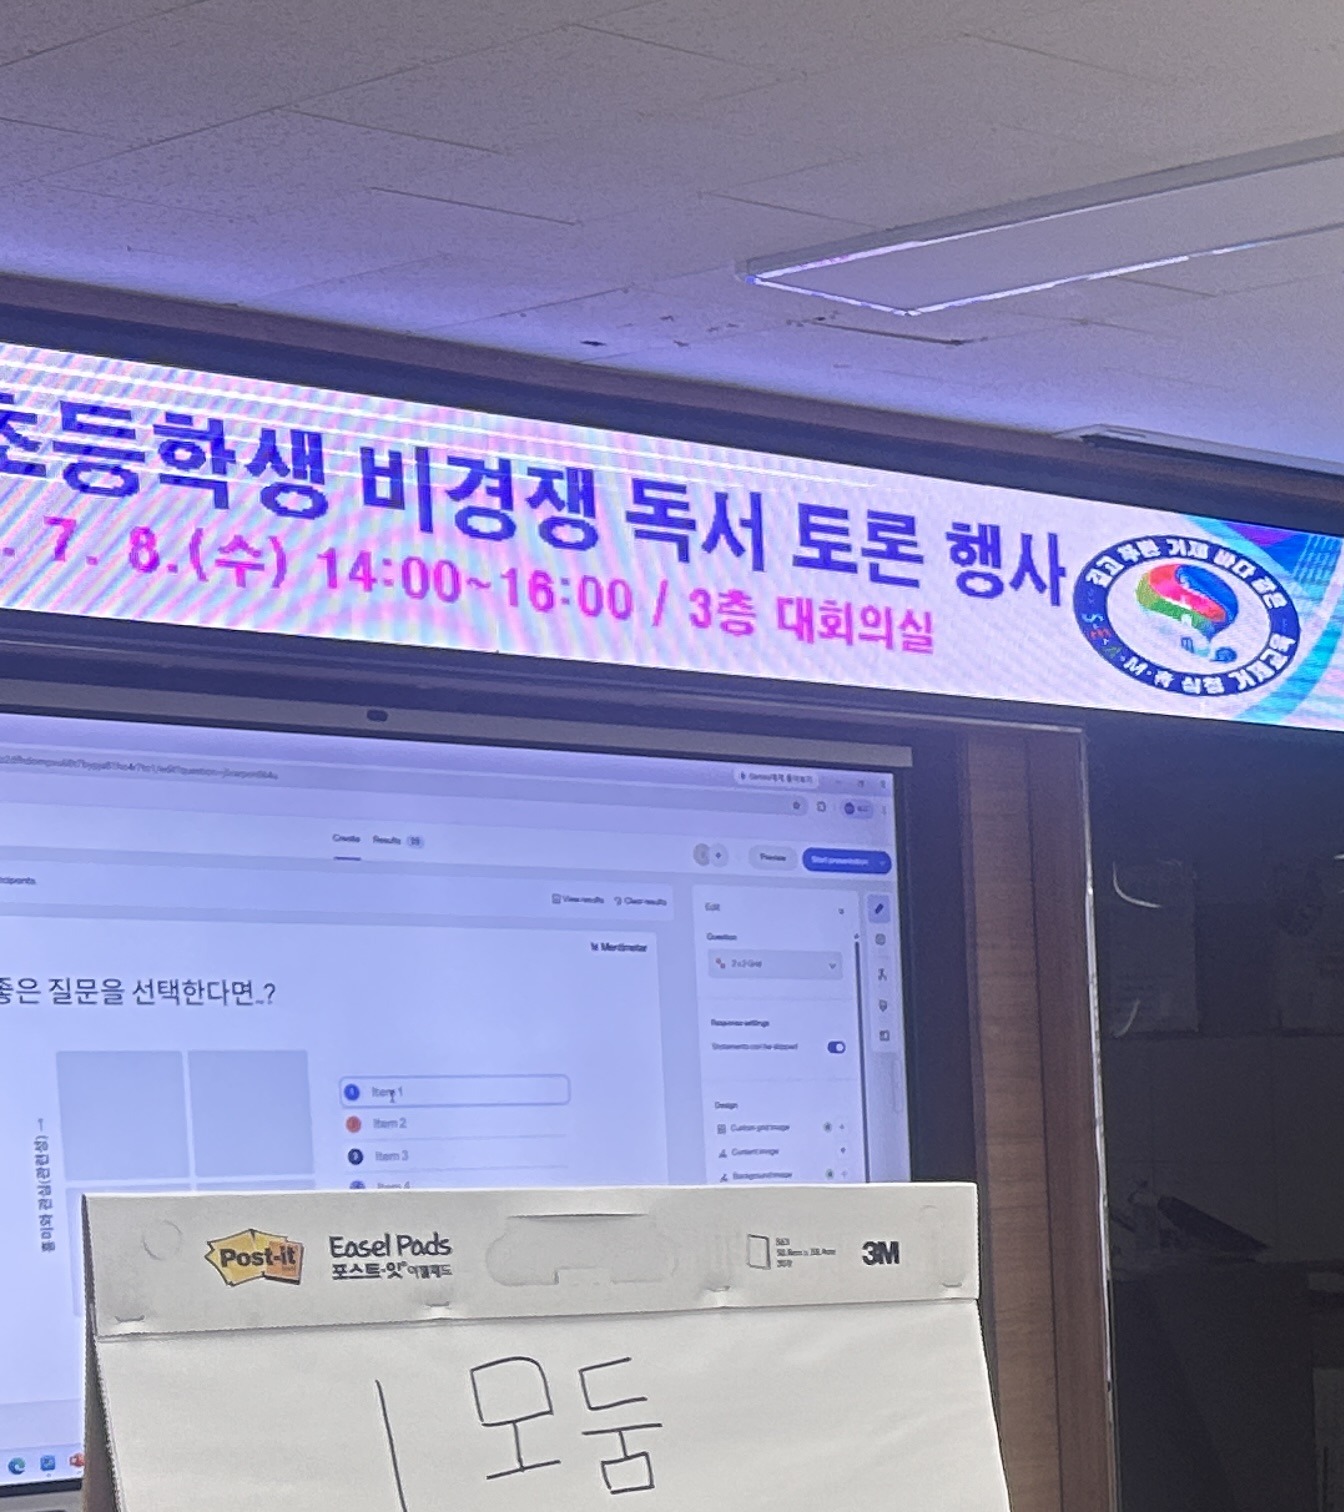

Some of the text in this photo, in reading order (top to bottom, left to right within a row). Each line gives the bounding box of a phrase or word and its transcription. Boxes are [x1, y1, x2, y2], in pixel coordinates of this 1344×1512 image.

[358, 444, 601, 552] 비경쟁
[624, 476, 763, 573] 독서
[792, 501, 924, 590] 토론
[945, 518, 1066, 608] 행사
[689, 586, 758, 638] 3층
[776, 594, 936, 655] 대회의실
[48, 976, 125, 1005] 질문을
[219, 1231, 900, 1268] Post-it Easel Pads 3M
[469, 1355, 665, 1497] 모둠
